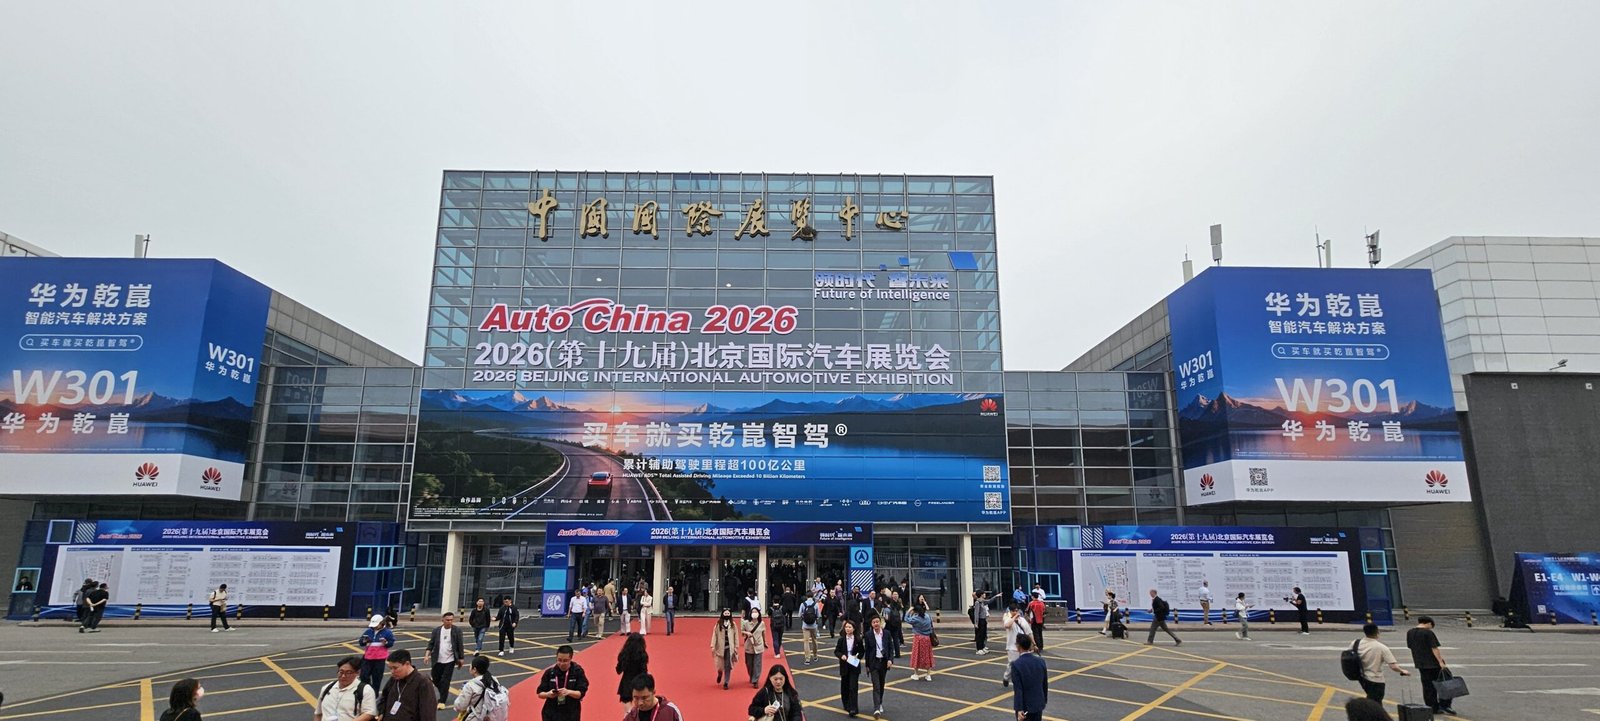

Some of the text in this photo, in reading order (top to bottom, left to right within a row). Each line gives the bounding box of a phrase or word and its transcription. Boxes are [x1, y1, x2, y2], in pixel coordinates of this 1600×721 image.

[28, 283, 152, 308] 华为乾崑
[814, 288, 950, 301] Future of Intelligence
[1265, 292, 1383, 317] 华为乾崑
[25, 311, 147, 326] 智能汽车解决方案
[478, 298, 799, 335] Auto China 2026
[1268, 320, 1386, 335] 智能汽车解决方案
[208, 342, 255, 373] W301
[474, 340, 951, 371] 2026(第十九届)北京国际汽车展览会
[1179, 350, 1214, 379] W301
[12, 369, 139, 405] W301
[472, 370, 954, 386] 2026 BEIJING INTERNATIONAL AUTOMOTIVE EXHIBITION
[1275, 377, 1400, 413] W301
[1, 412, 131, 434] 华为乾崑
[1281, 420, 1405, 442] 华为乾崑
[623, 458, 806, 471] 累计辅助驾驶里程超100亿公里
[1534, 572, 1600, 582] E1-E4 W1-W
